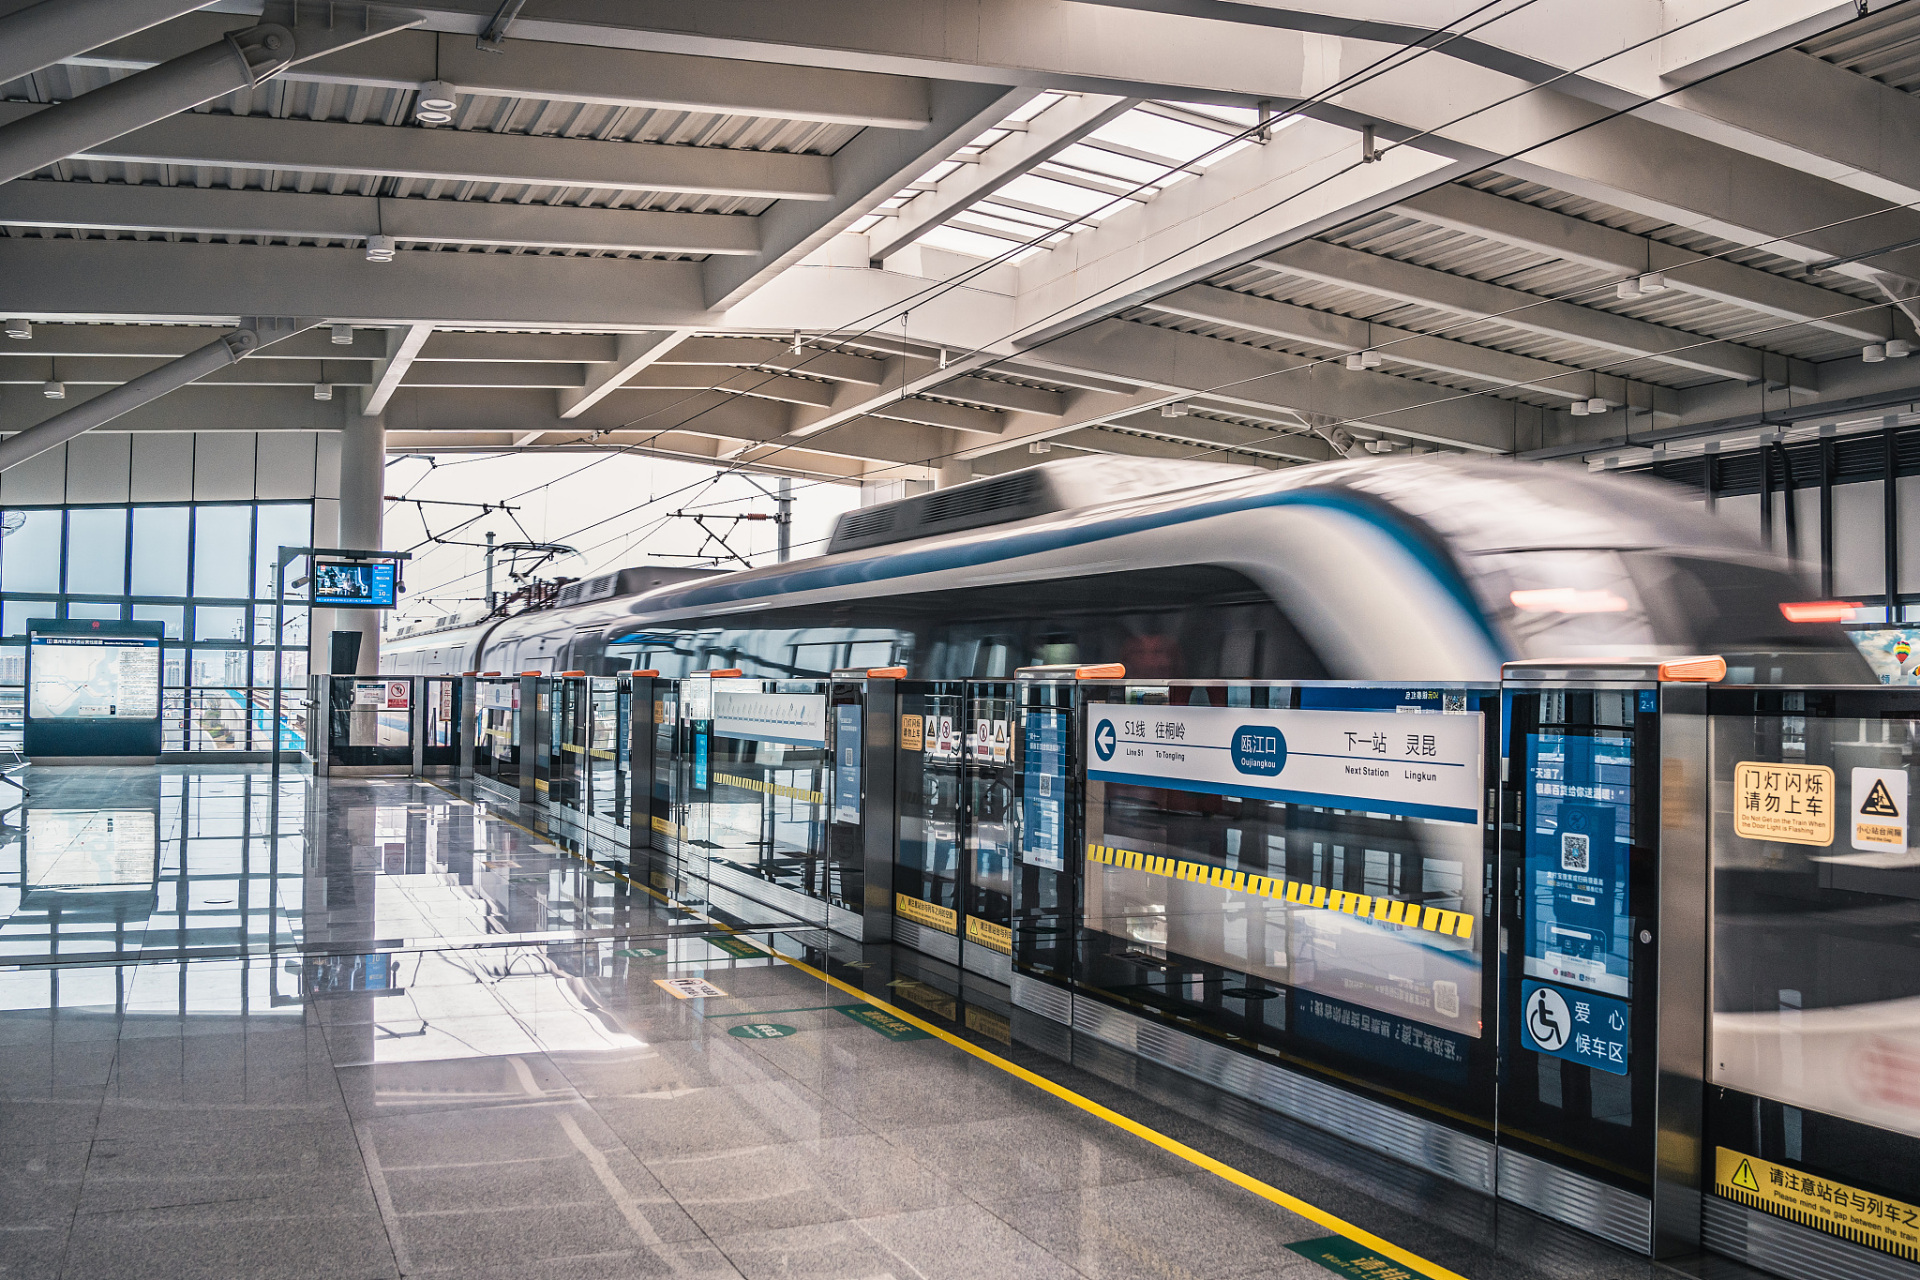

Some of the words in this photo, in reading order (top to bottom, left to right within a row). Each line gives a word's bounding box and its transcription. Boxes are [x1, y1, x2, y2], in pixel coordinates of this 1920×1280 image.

[1641, 700, 1654, 709] 2-1
[1124, 720, 1146, 738] S1线
[1156, 722, 1186, 740] 往桐岭
[1126, 748, 1136, 756] Line
[1137, 749, 1144, 757] S1
[1241, 734, 1276, 754] 瓯江口
[1344, 732, 1387, 754] 下一站
[1406, 734, 1436, 756] 灵昆
[1156, 750, 1163, 758] To
[1164, 752, 1184, 762] Tongling
[1241, 758, 1276, 769] Oujiangkou
[1345, 765, 1361, 776] Next
[1362, 766, 1389, 777] Station
[1404, 770, 1436, 782] Lingkun
[1745, 770, 1823, 794] 门灯闪烁
[1744, 790, 1823, 816] 请勿上车
[1752, 822, 1765, 830] Door
[1766, 823, 1781, 832] Light
[1789, 826, 1814, 835] Flashing
[1792, 818, 1808, 826] Train
[1574, 1001, 1624, 1032] 爱心
[1575, 1032, 1624, 1063] 候车区
[1769, 1166, 1920, 1230] 请注意站台与列车之
[1774, 1190, 1797, 1204] Please
[1800, 1199, 1817, 1210] mind
[1820, 1204, 1831, 1214] the
[1834, 1209, 1848, 1221] gap
[1851, 1214, 1882, 1231] between
[1885, 1225, 1897, 1236] the
[1900, 1228, 1918, 1242] train
[1321, 1252, 1350, 1268] Wait
